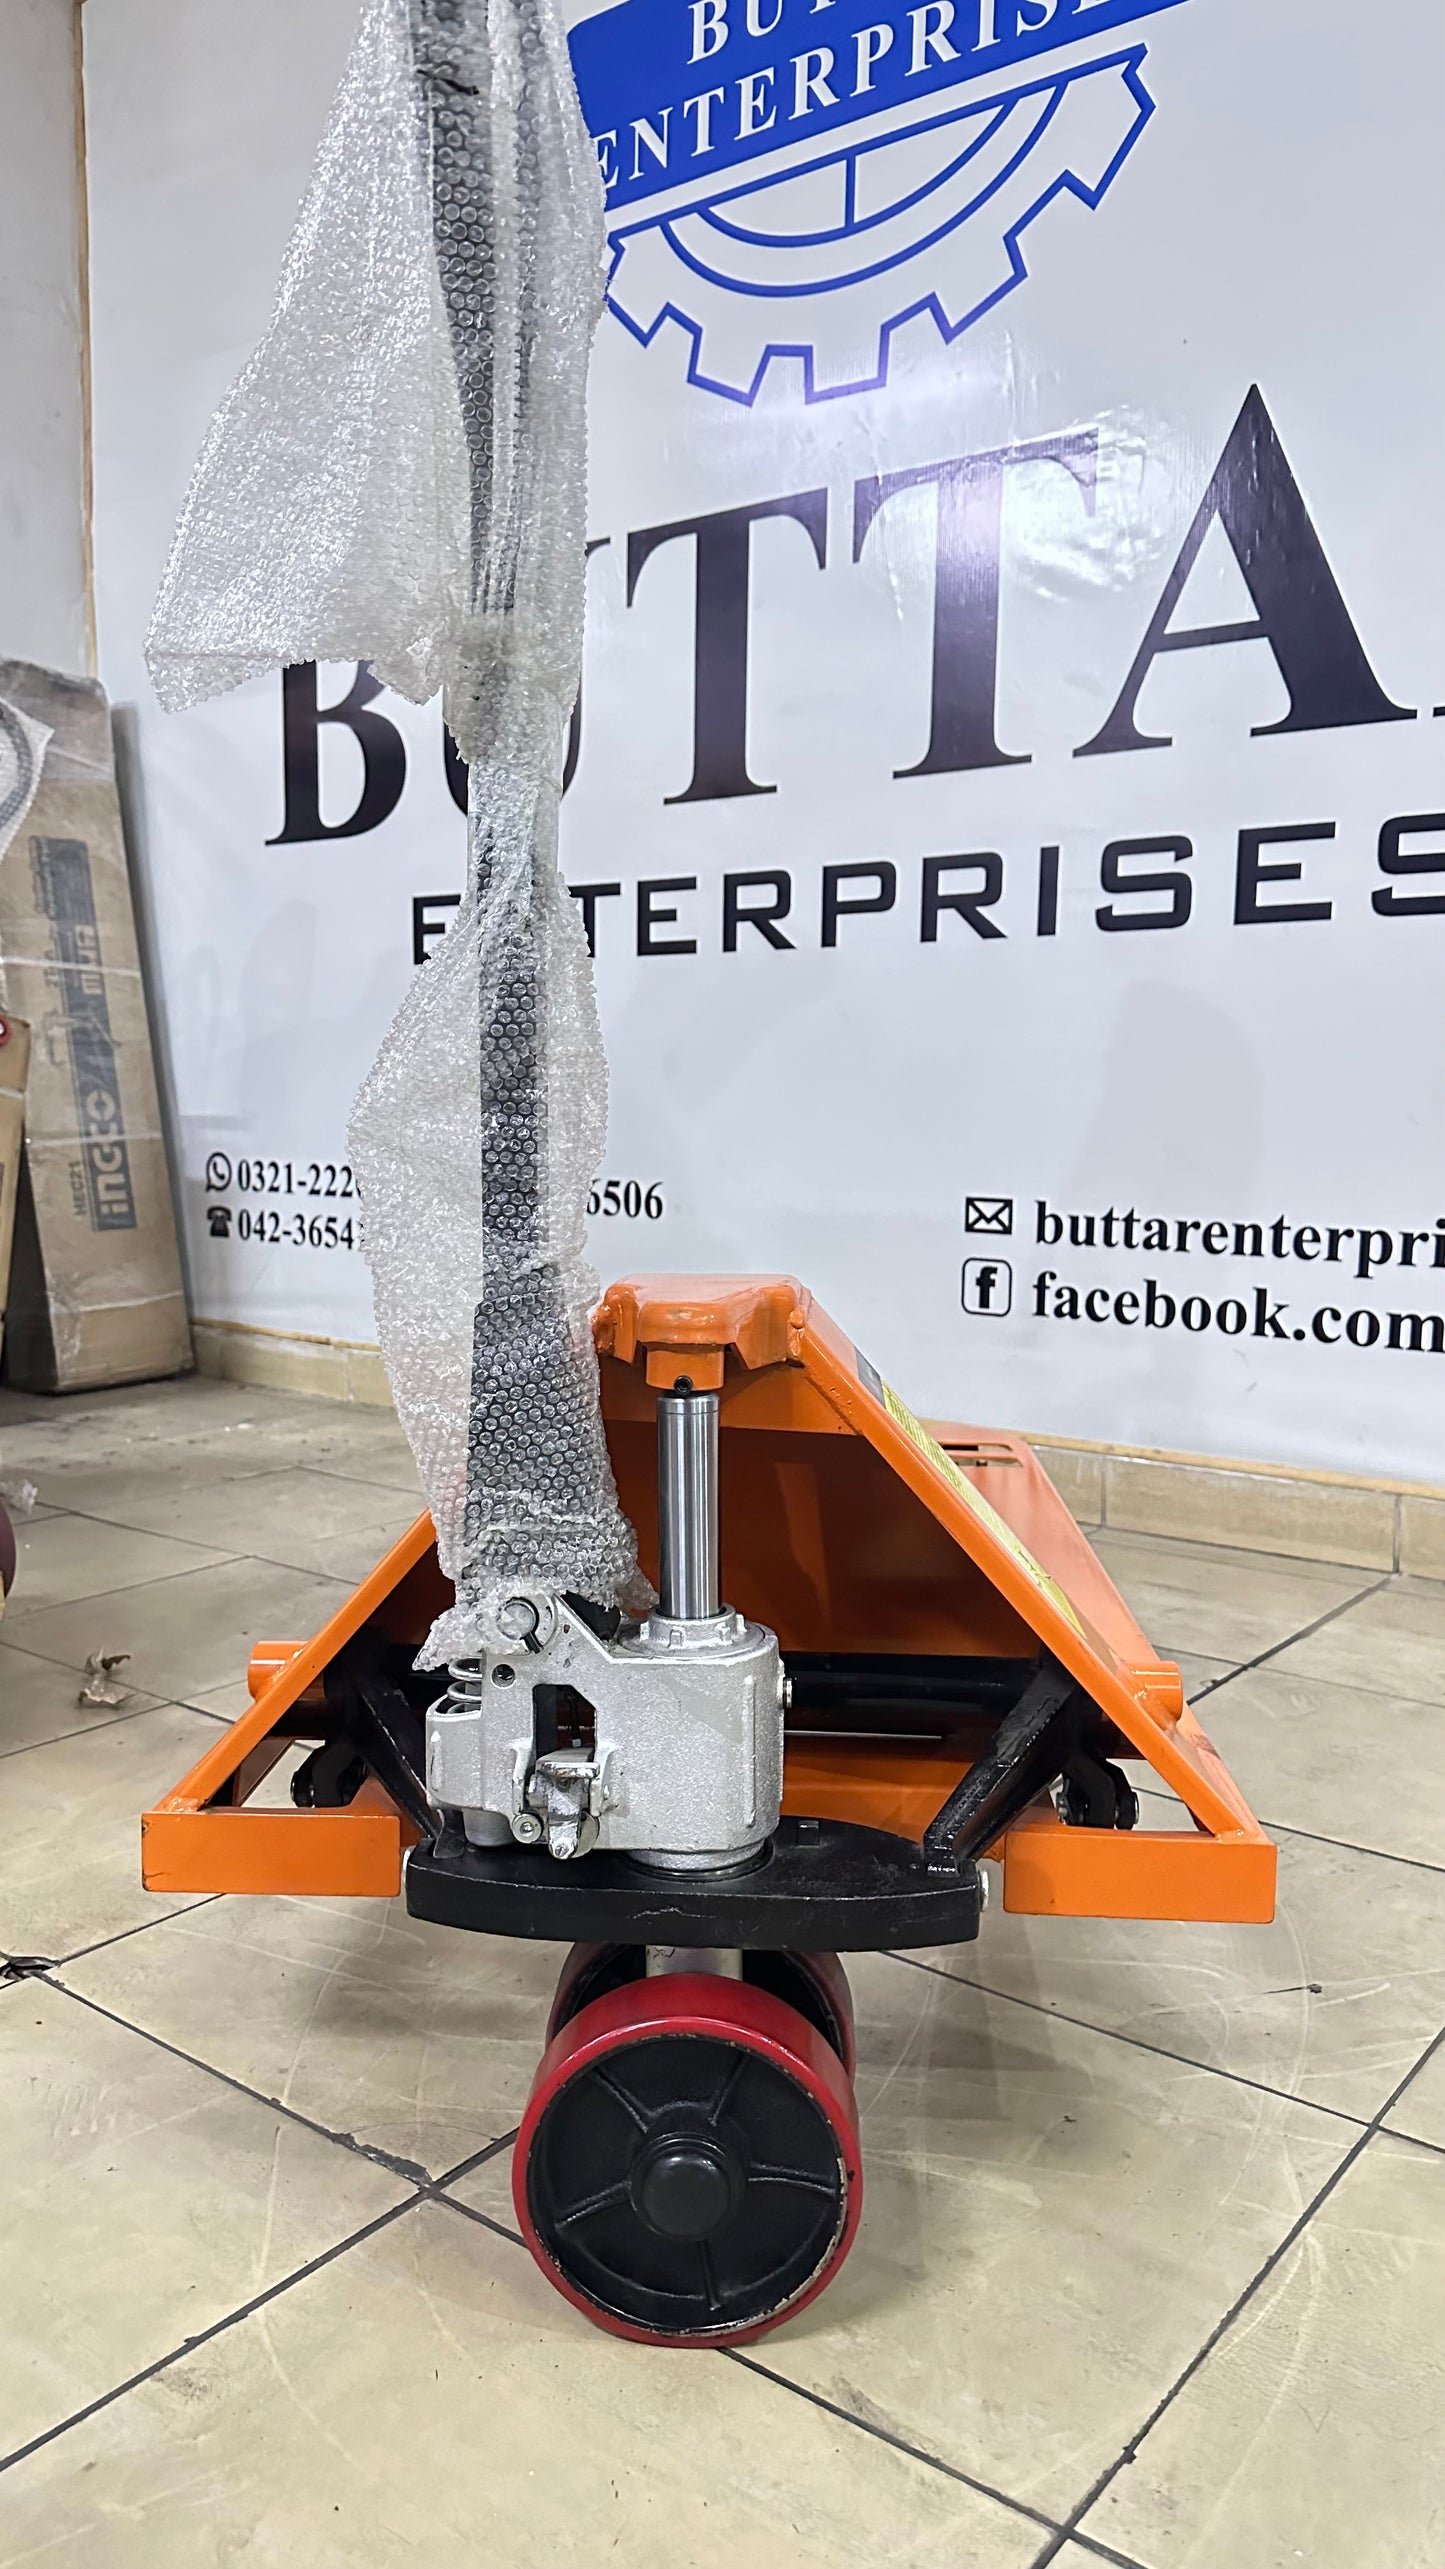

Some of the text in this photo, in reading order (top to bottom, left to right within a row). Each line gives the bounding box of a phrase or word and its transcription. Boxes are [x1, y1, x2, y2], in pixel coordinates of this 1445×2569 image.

[686, 0, 837, 65] BU
[412, 812, 1445, 965] ETERPRISES
[238, 1159, 362, 1198] 0321-222
[238, 1208, 365, 1250] 042-3654
[1035, 1199, 1445, 1280] buttarenterpri
[1032, 1270, 1445, 1354] facebook.com
